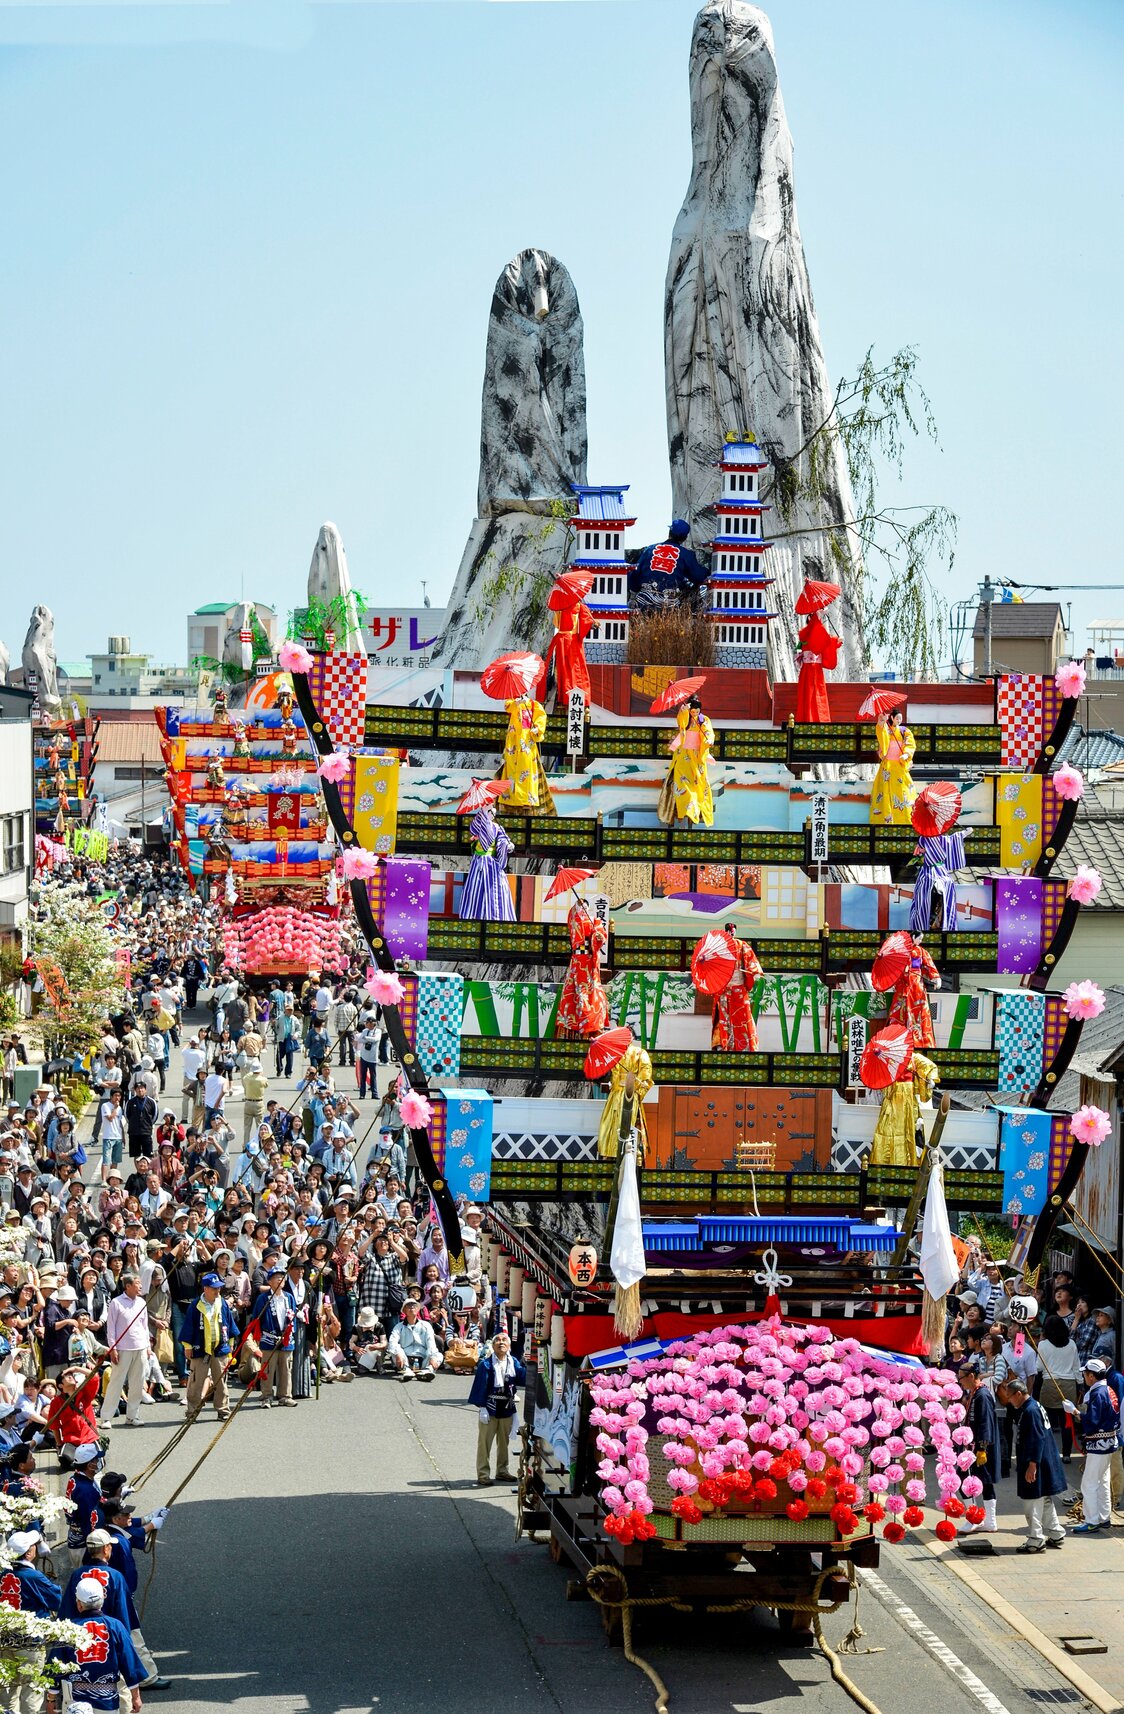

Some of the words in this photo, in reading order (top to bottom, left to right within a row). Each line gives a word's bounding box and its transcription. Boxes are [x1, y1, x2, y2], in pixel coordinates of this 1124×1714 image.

[569, 694, 583, 749] 仇討本懐
[814, 796, 826, 857] 清水一角の最期
[577, 1251, 592, 1282] 本西
